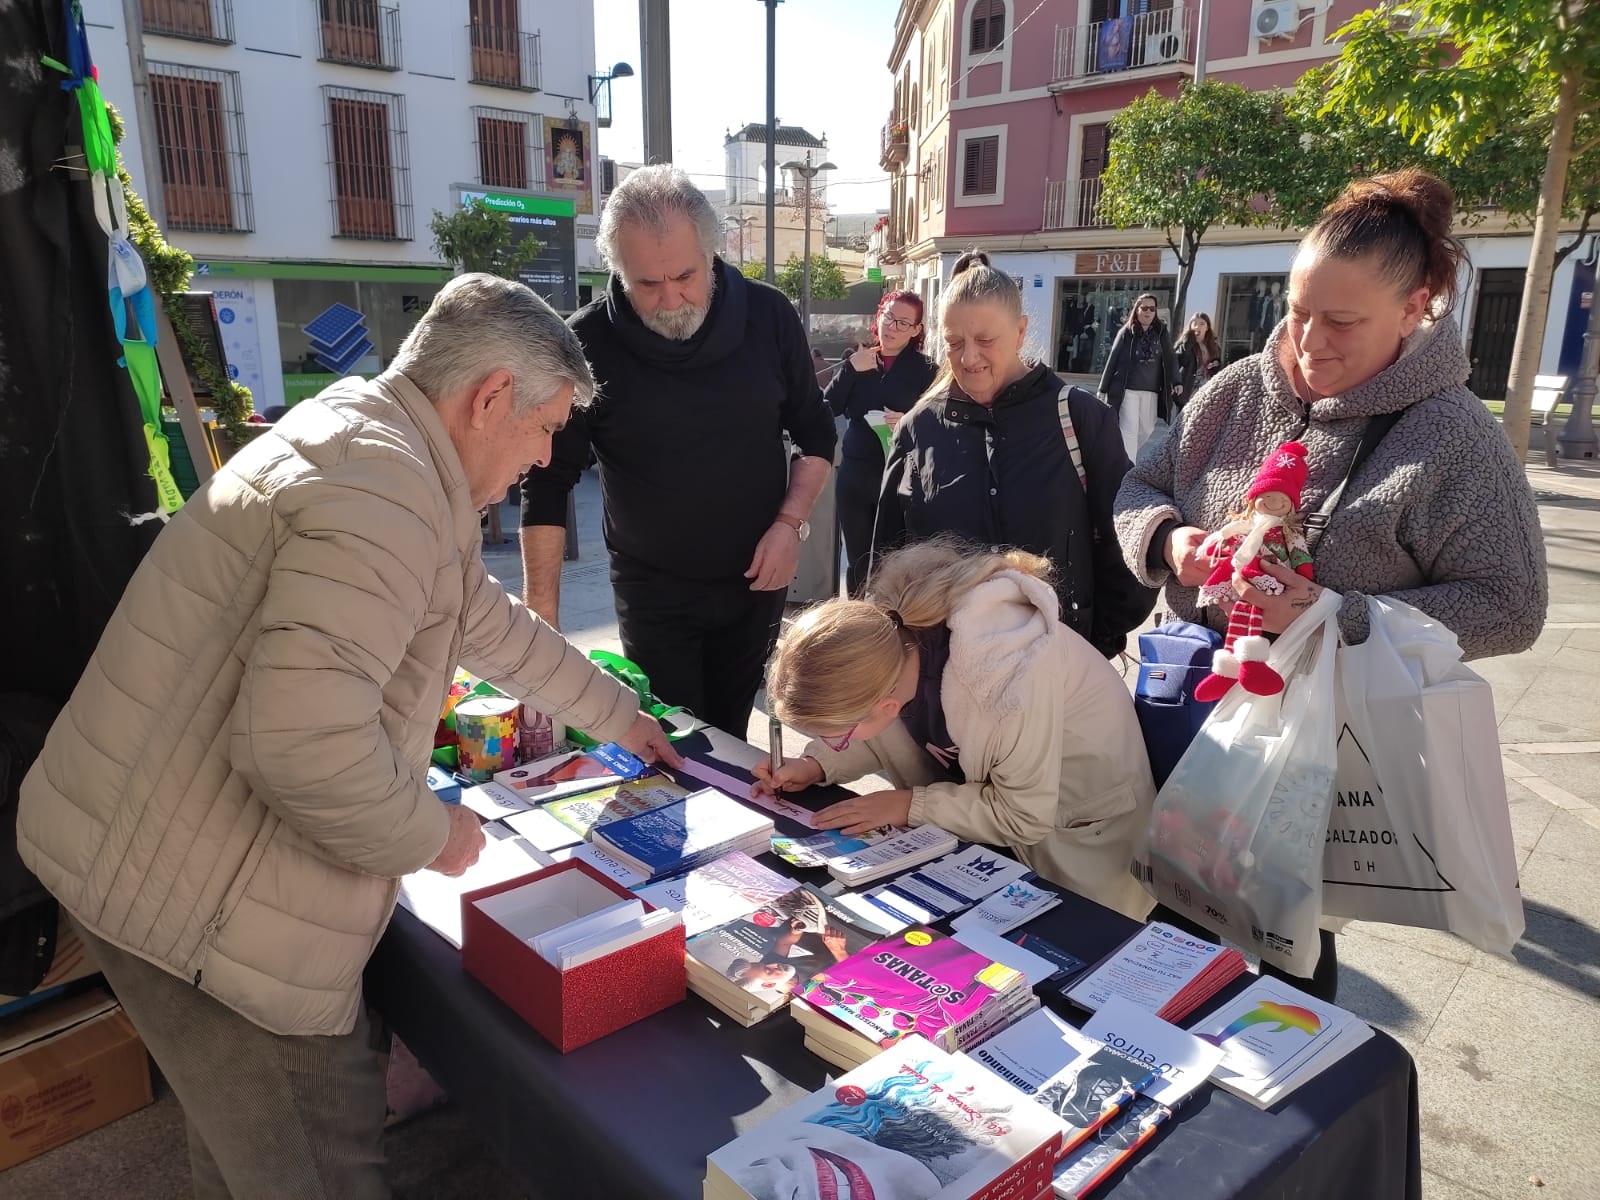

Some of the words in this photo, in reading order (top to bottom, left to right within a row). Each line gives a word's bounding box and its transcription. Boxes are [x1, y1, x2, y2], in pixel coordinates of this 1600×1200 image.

[485, 197, 516, 208] Predicción
[1095, 253, 1142, 273] F&H
[1337, 790, 1375, 807] ANA
[591, 849, 615, 870] euros
[613, 866, 631, 878] 12
[720, 941, 741, 958] Sigue
[873, 952, 965, 1005] S@TANAS
[854, 1012, 895, 1041] FRANCISCO
[1103, 1031, 1157, 1063] euros
[1159, 1062, 1185, 1079] 10
[930, 1083, 944, 1095] de
[947, 1094, 983, 1123] Sonrisa
